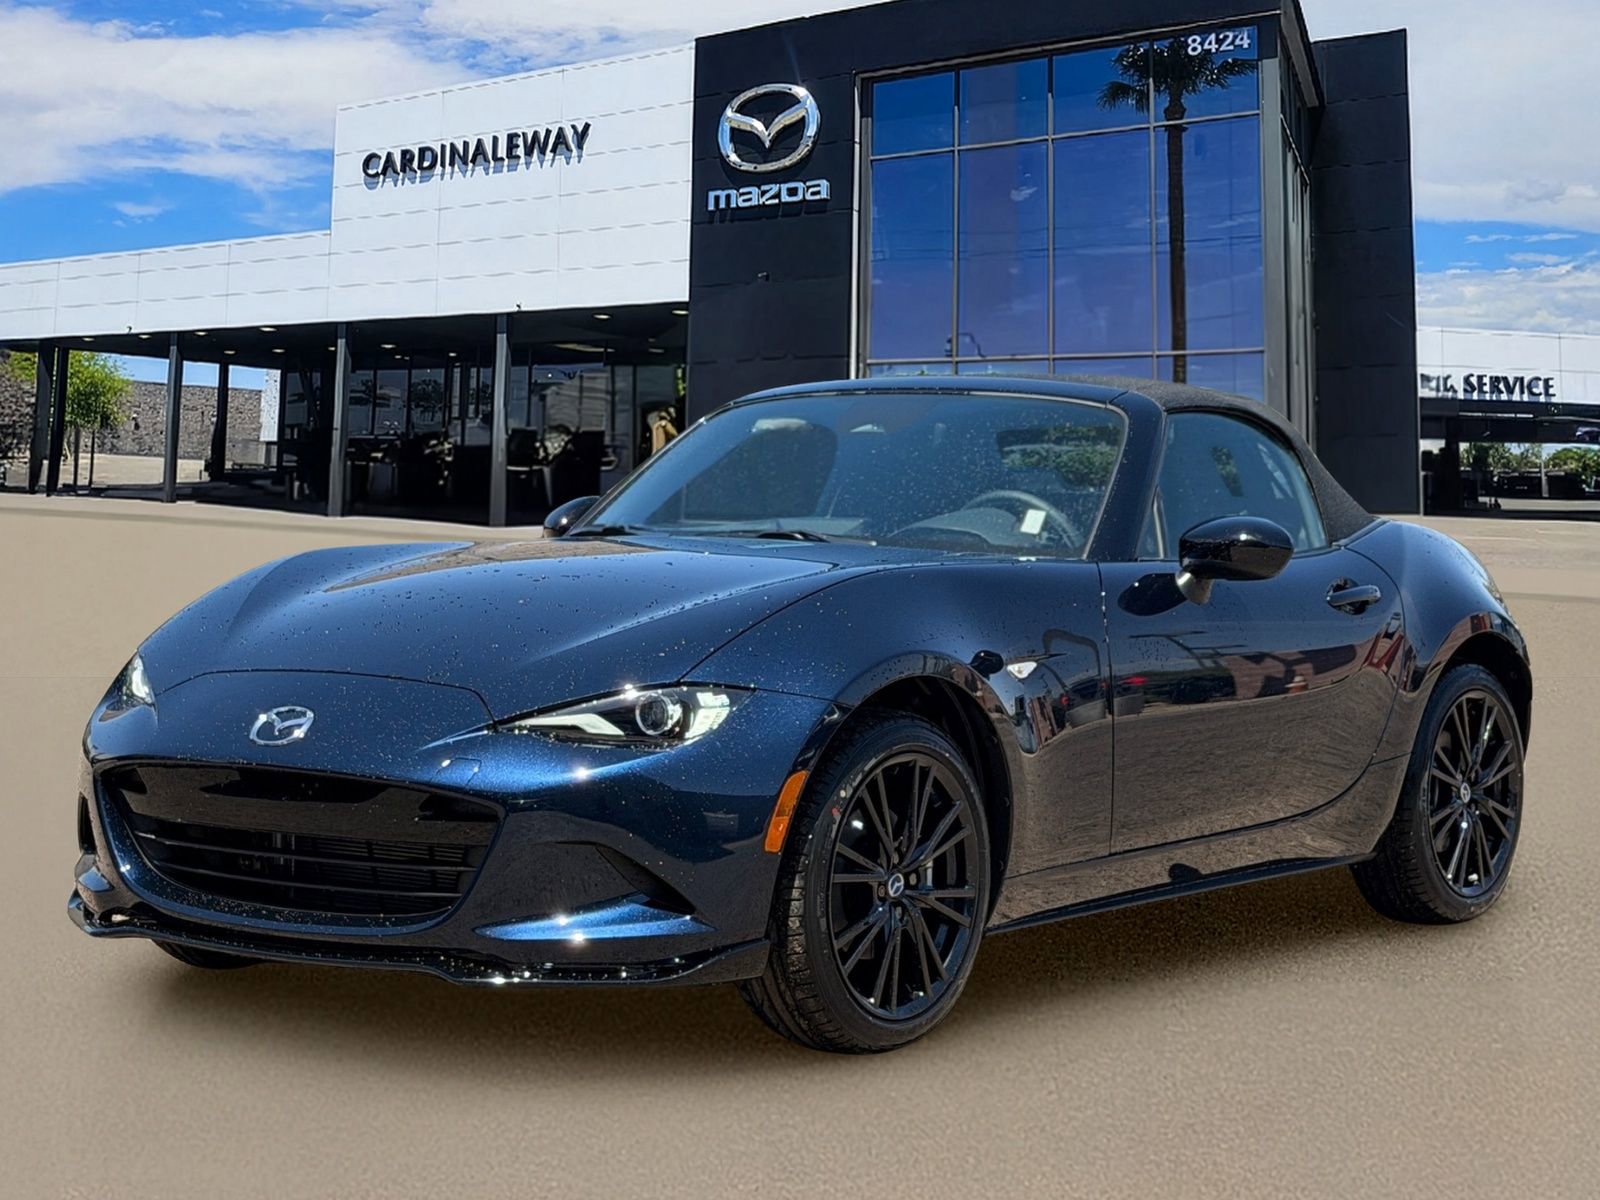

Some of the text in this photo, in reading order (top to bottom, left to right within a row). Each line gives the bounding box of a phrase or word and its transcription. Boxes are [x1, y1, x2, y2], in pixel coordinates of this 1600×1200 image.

[1187, 29, 1251, 56] 8424
[362, 121, 592, 179] CARDINALEWAY
[707, 179, 831, 212] mazda
[1463, 373, 1557, 397] SERVICE
